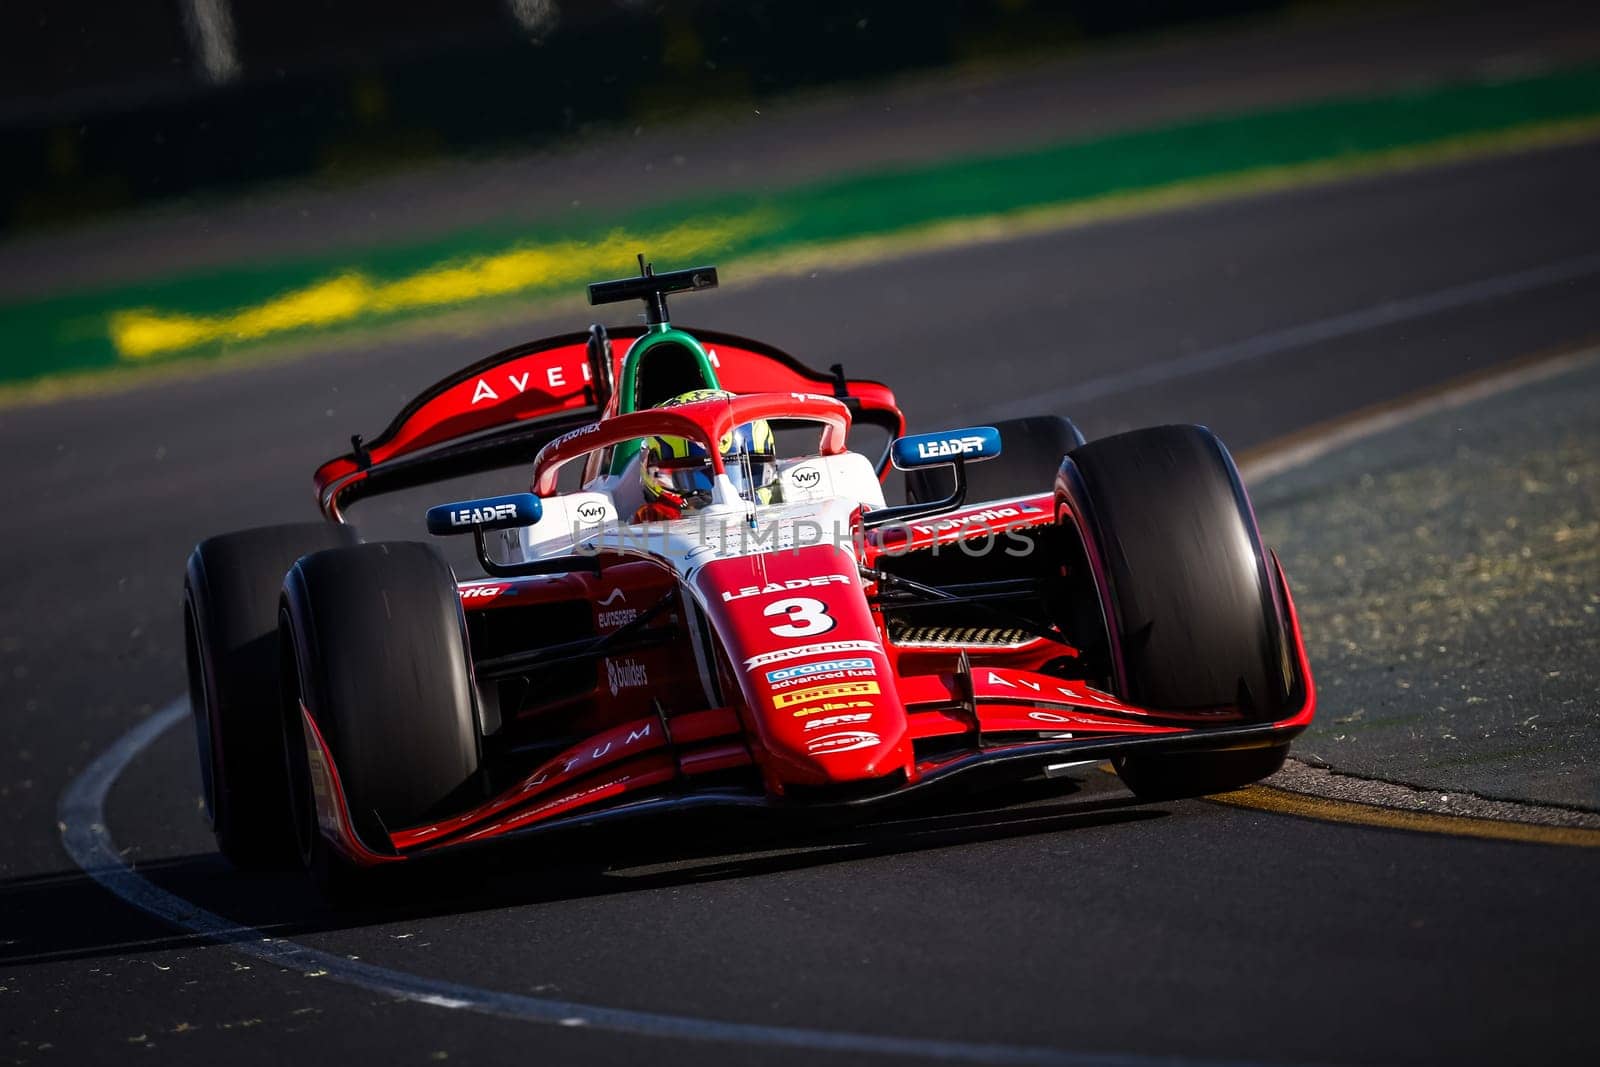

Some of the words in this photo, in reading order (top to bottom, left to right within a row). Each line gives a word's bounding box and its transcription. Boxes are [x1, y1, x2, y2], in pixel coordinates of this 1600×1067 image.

[918, 436, 985, 458] LEADER
[450, 503, 517, 526] LEADER
[721, 574, 851, 602] LEADER
[763, 597, 837, 638] 3
[757, 642, 866, 663] RAVENOL
[771, 671, 844, 690] advanced
[847, 668, 876, 677] fuel
[772, 660, 867, 680] aramco
